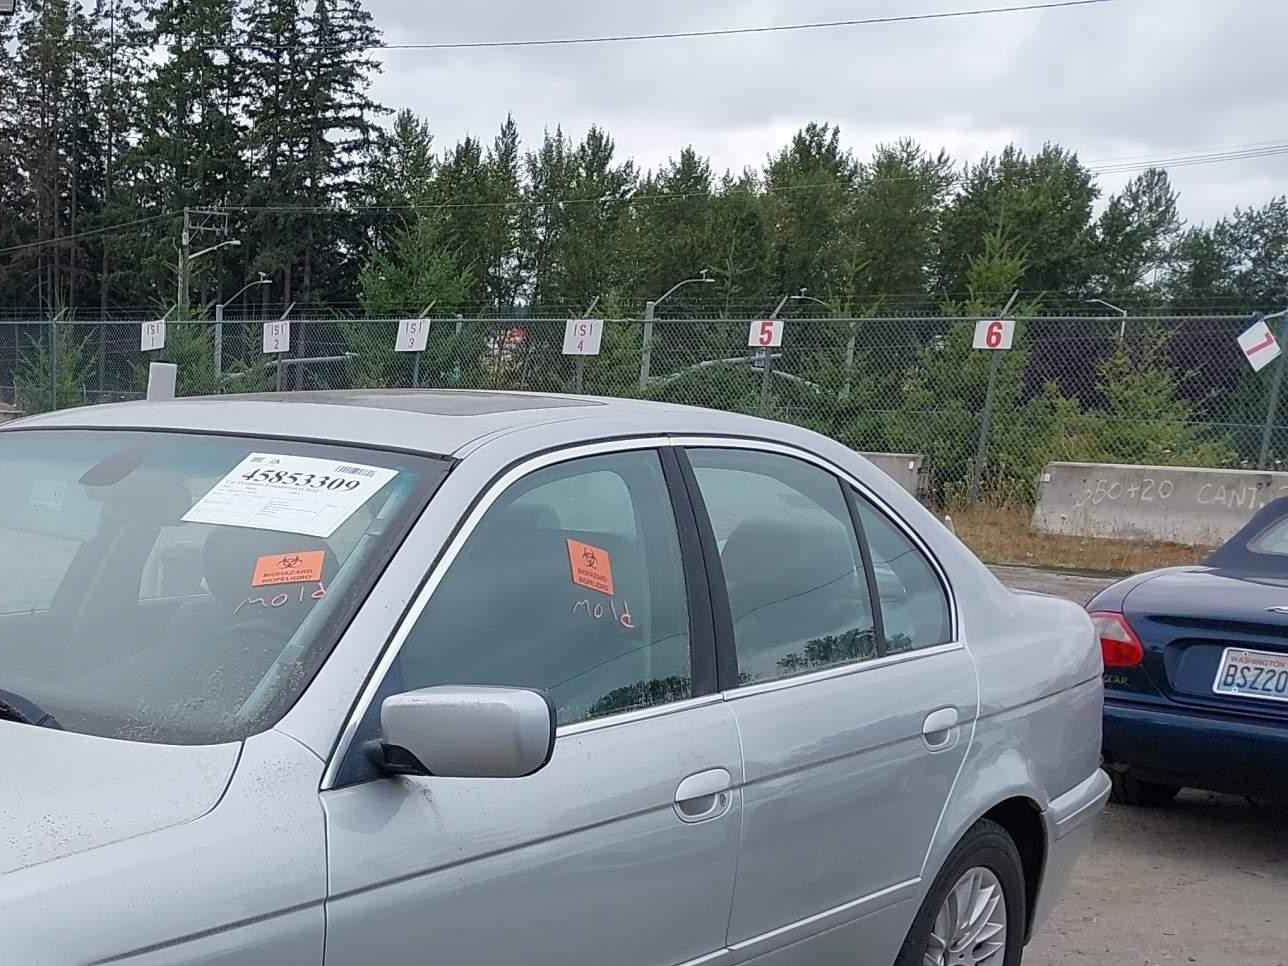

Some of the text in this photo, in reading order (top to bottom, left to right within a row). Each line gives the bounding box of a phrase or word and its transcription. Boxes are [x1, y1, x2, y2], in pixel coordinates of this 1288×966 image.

[759, 321, 774, 346] 5
[985, 321, 1003, 348] 6
[273, 338, 280, 350] 2
[407, 337, 416, 349] 3
[577, 339, 584, 352] 4
[242, 468, 361, 492] 45853309
[1231, 655, 1286, 668] WASHINGTON
